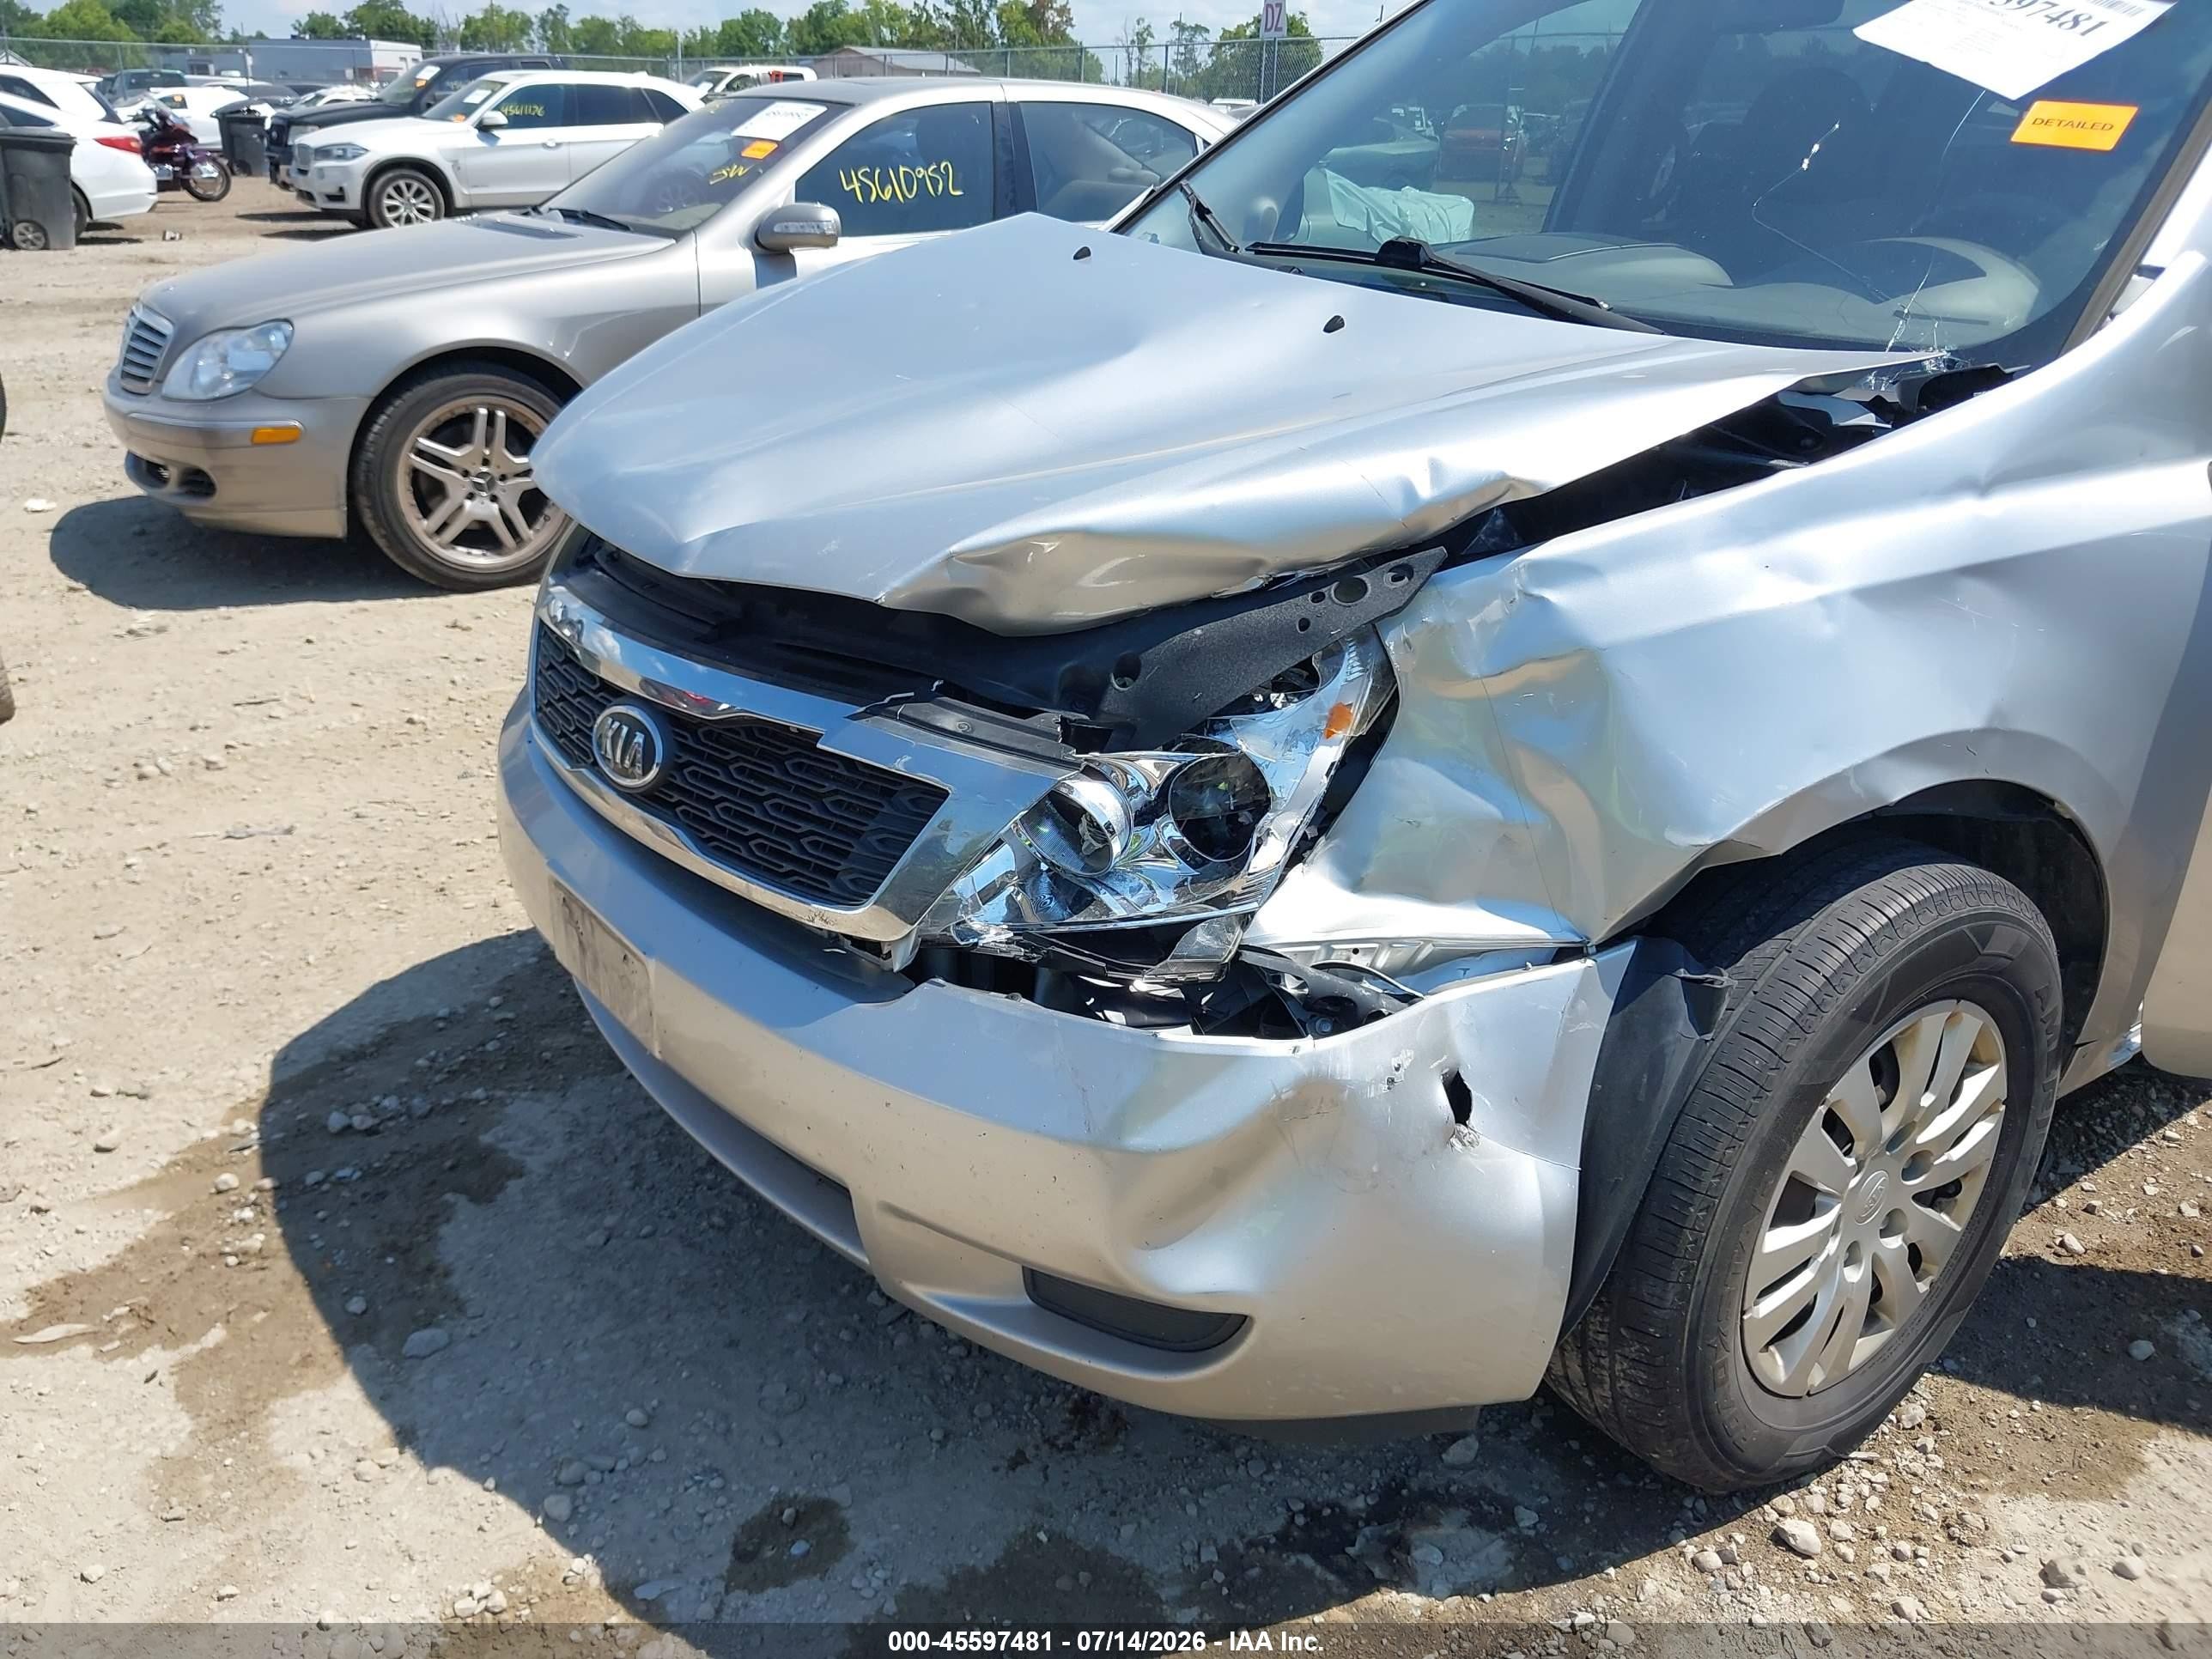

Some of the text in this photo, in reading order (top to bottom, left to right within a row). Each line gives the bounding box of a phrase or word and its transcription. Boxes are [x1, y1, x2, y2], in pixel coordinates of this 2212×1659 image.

[2032, 118, 2114, 131] DETAILED
[838, 161, 964, 204] 45610952
[600, 716, 645, 780] KIA
